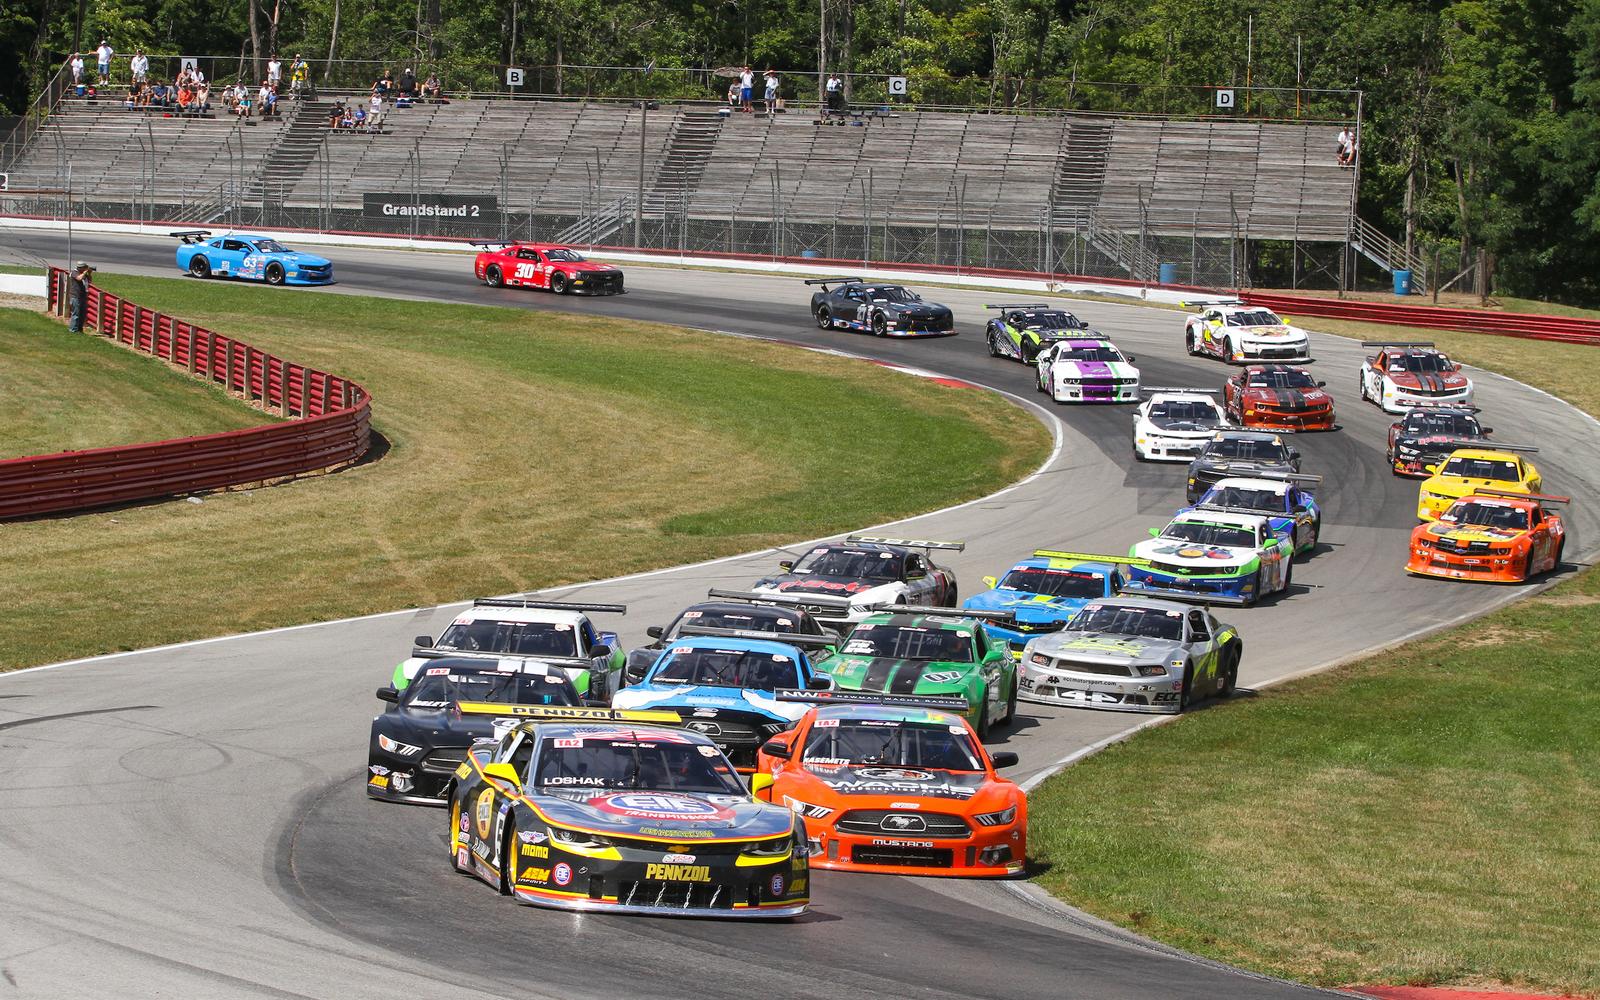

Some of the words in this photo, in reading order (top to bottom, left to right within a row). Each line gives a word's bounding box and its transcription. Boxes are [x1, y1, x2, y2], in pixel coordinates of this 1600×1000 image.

[186, 62, 193, 72] A
[511, 72, 519, 82] B
[893, 81, 902, 91] C
[1221, 94, 1230, 104] D
[382, 203, 467, 217] Grandstand
[472, 206, 480, 217] 2
[244, 257, 257, 268] 63
[515, 263, 535, 278] 30
[544, 777, 605, 786] LOSHAK
[873, 839, 935, 848] MUSTANG
[645, 863, 712, 882] PENNZOIL
